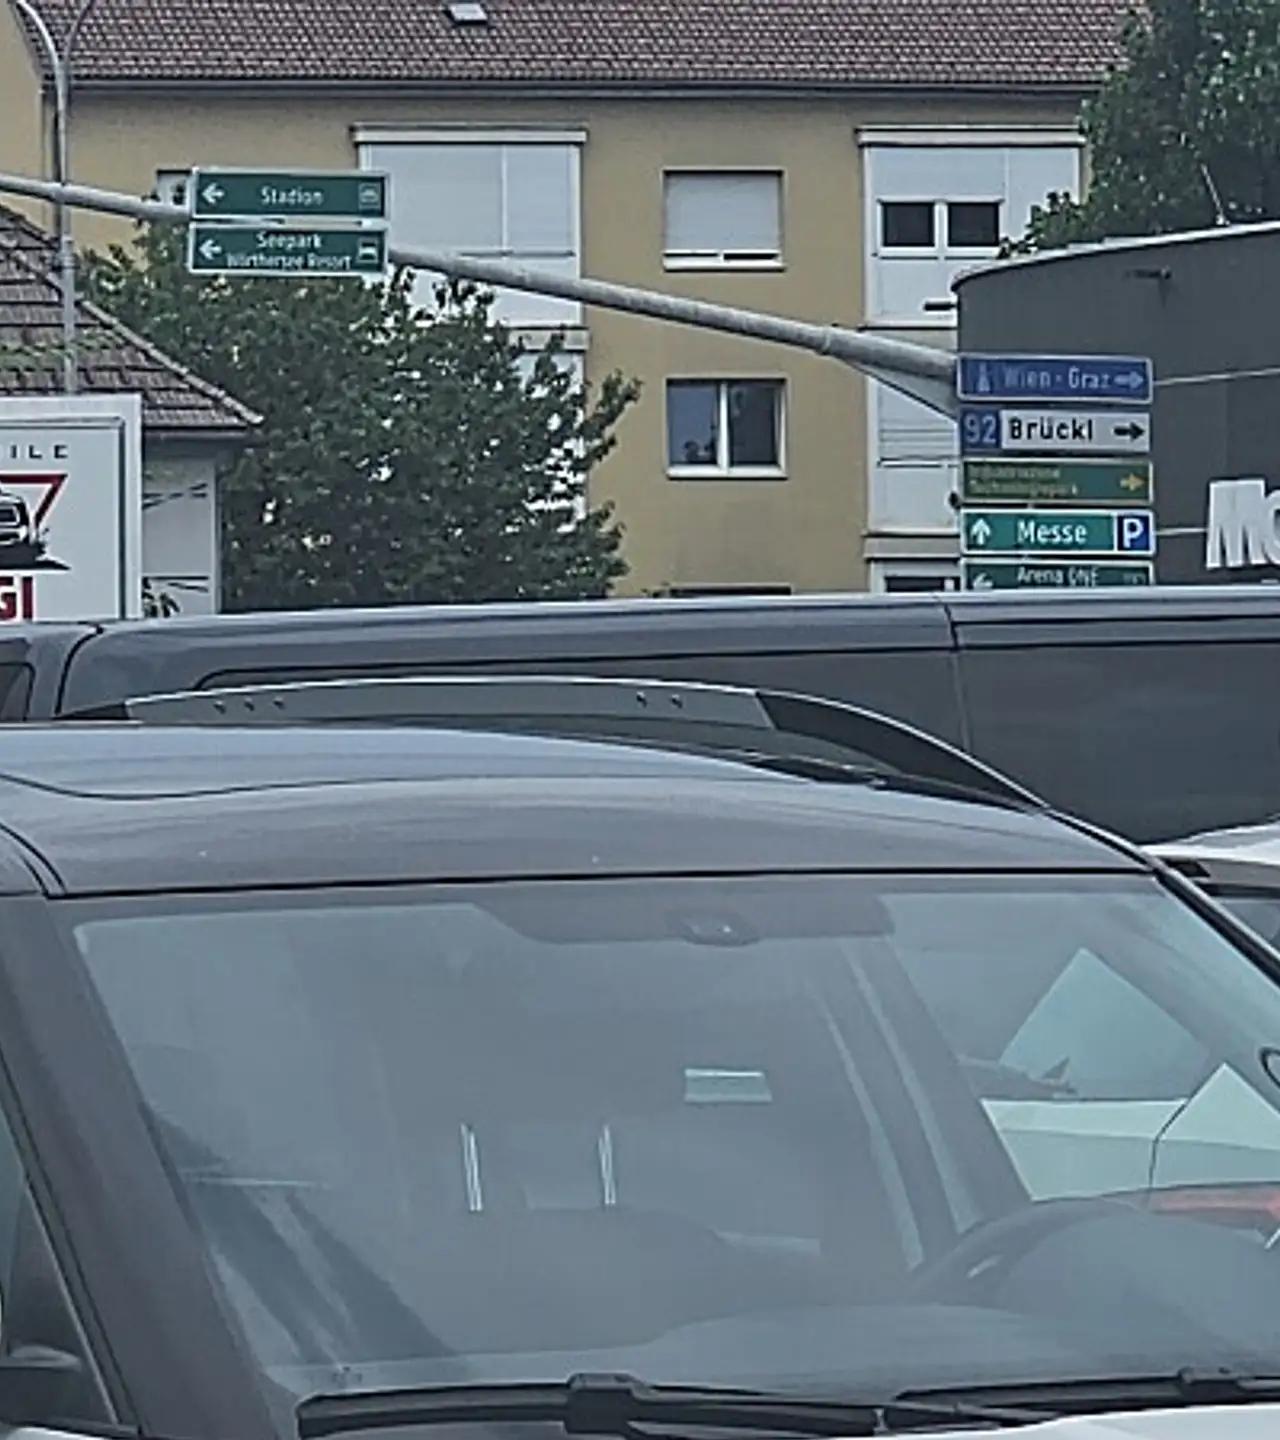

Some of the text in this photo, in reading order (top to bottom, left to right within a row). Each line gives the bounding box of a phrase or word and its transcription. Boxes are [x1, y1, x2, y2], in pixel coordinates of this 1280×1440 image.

[260, 186, 323, 206] Stadion
[1067, 365, 1111, 390] Graz
[963, 413, 1094, 445] 92 Brückl
[1016, 517, 1145, 549] Messe P
